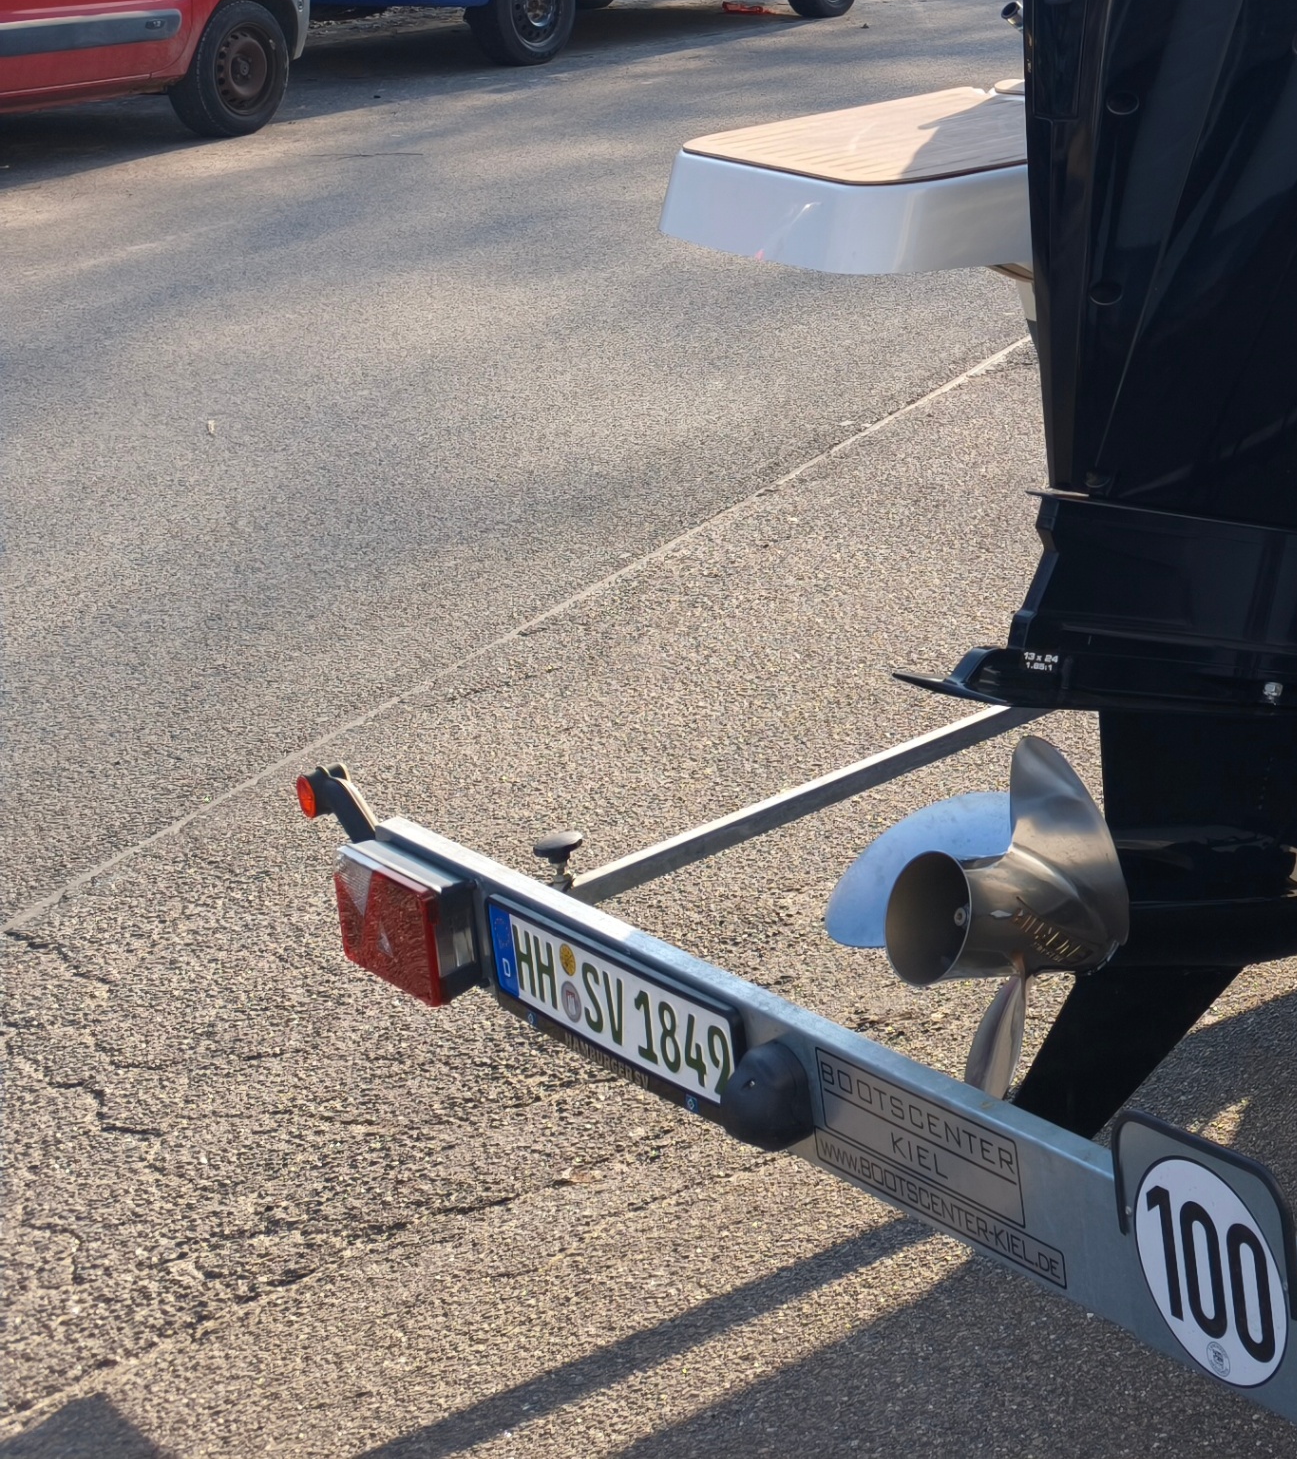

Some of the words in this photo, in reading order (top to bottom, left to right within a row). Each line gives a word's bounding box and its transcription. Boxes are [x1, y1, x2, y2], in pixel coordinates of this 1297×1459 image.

[502, 957, 512, 978] D
[512, 923, 559, 1011] HH
[582, 961, 624, 1047] SV
[634, 989, 732, 1095] 1849
[564, 1031, 634, 1082] HAMBURGER
[820, 1060, 1016, 1176] BOOTSCENTER
[891, 1131, 949, 1180] KIEL
[820, 1138, 1062, 1280] WWW.BOOTSCENTER-KIEL.DE
[1145, 1185, 1276, 1364] 100
